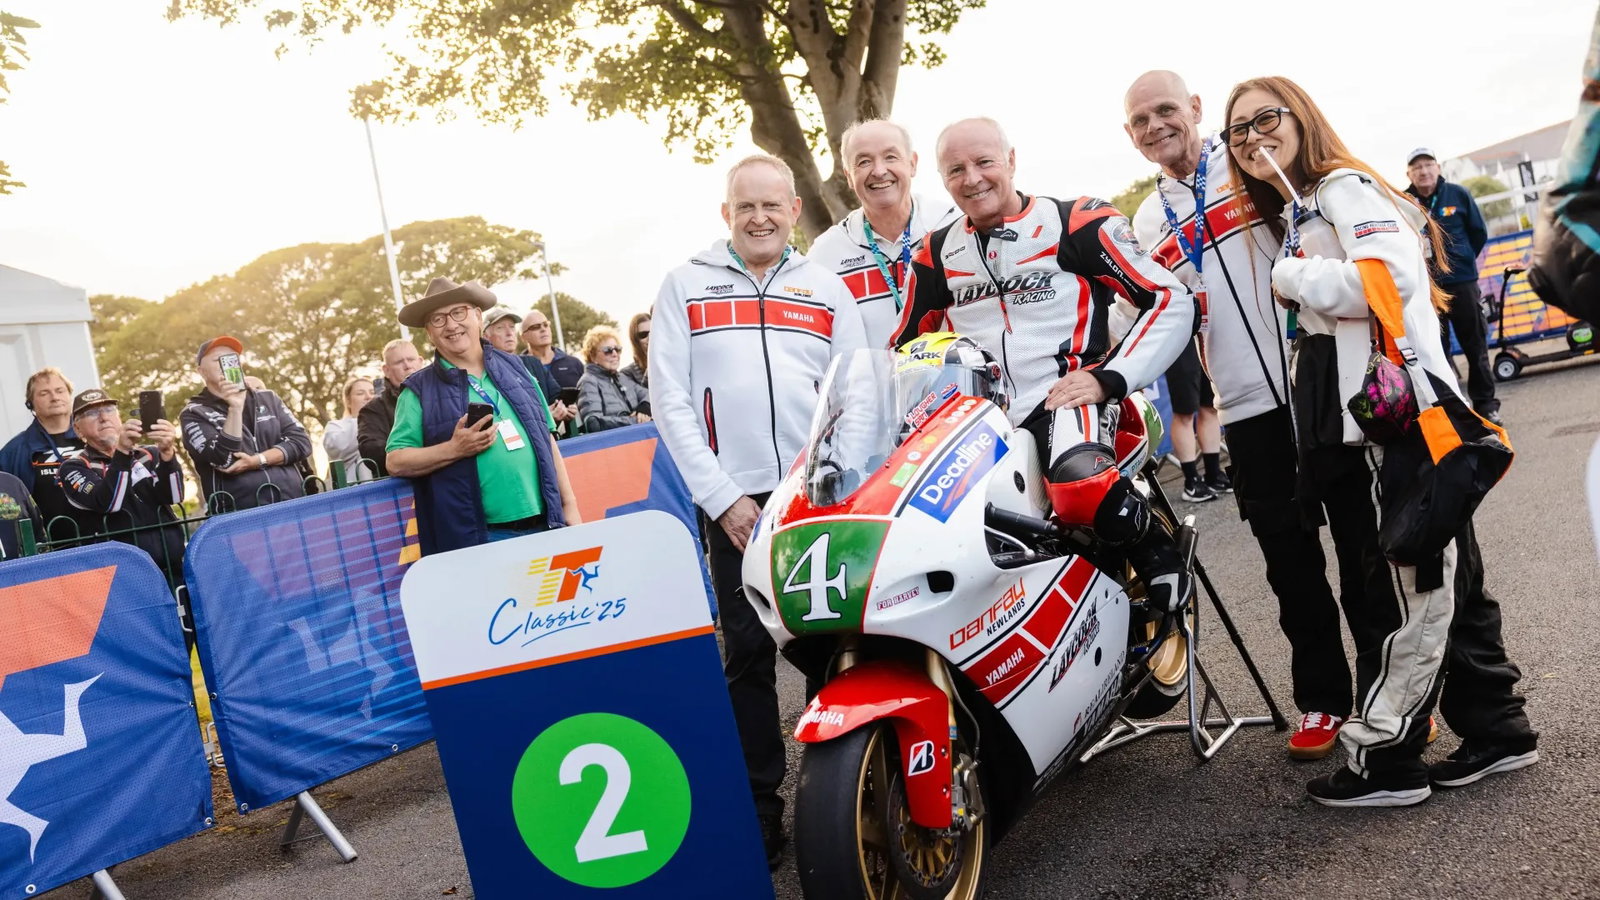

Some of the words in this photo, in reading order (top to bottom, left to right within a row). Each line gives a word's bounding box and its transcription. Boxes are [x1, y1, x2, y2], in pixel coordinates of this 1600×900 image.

[1224, 202, 1256, 220] YAMAH
[955, 271, 1059, 307] LAYCOCK
[1013, 289, 1056, 305] RACING
[783, 310, 815, 323] YAMAHA
[919, 432, 993, 505] Deadline
[782, 531, 848, 622] 4
[876, 599, 893, 611] FOR
[893, 586, 920, 605] HARVEY
[488, 597, 595, 646] Classic
[986, 599, 1026, 637] NEWLANDS
[985, 647, 1026, 686] YAMAHA
[559, 743, 648, 863] 2
